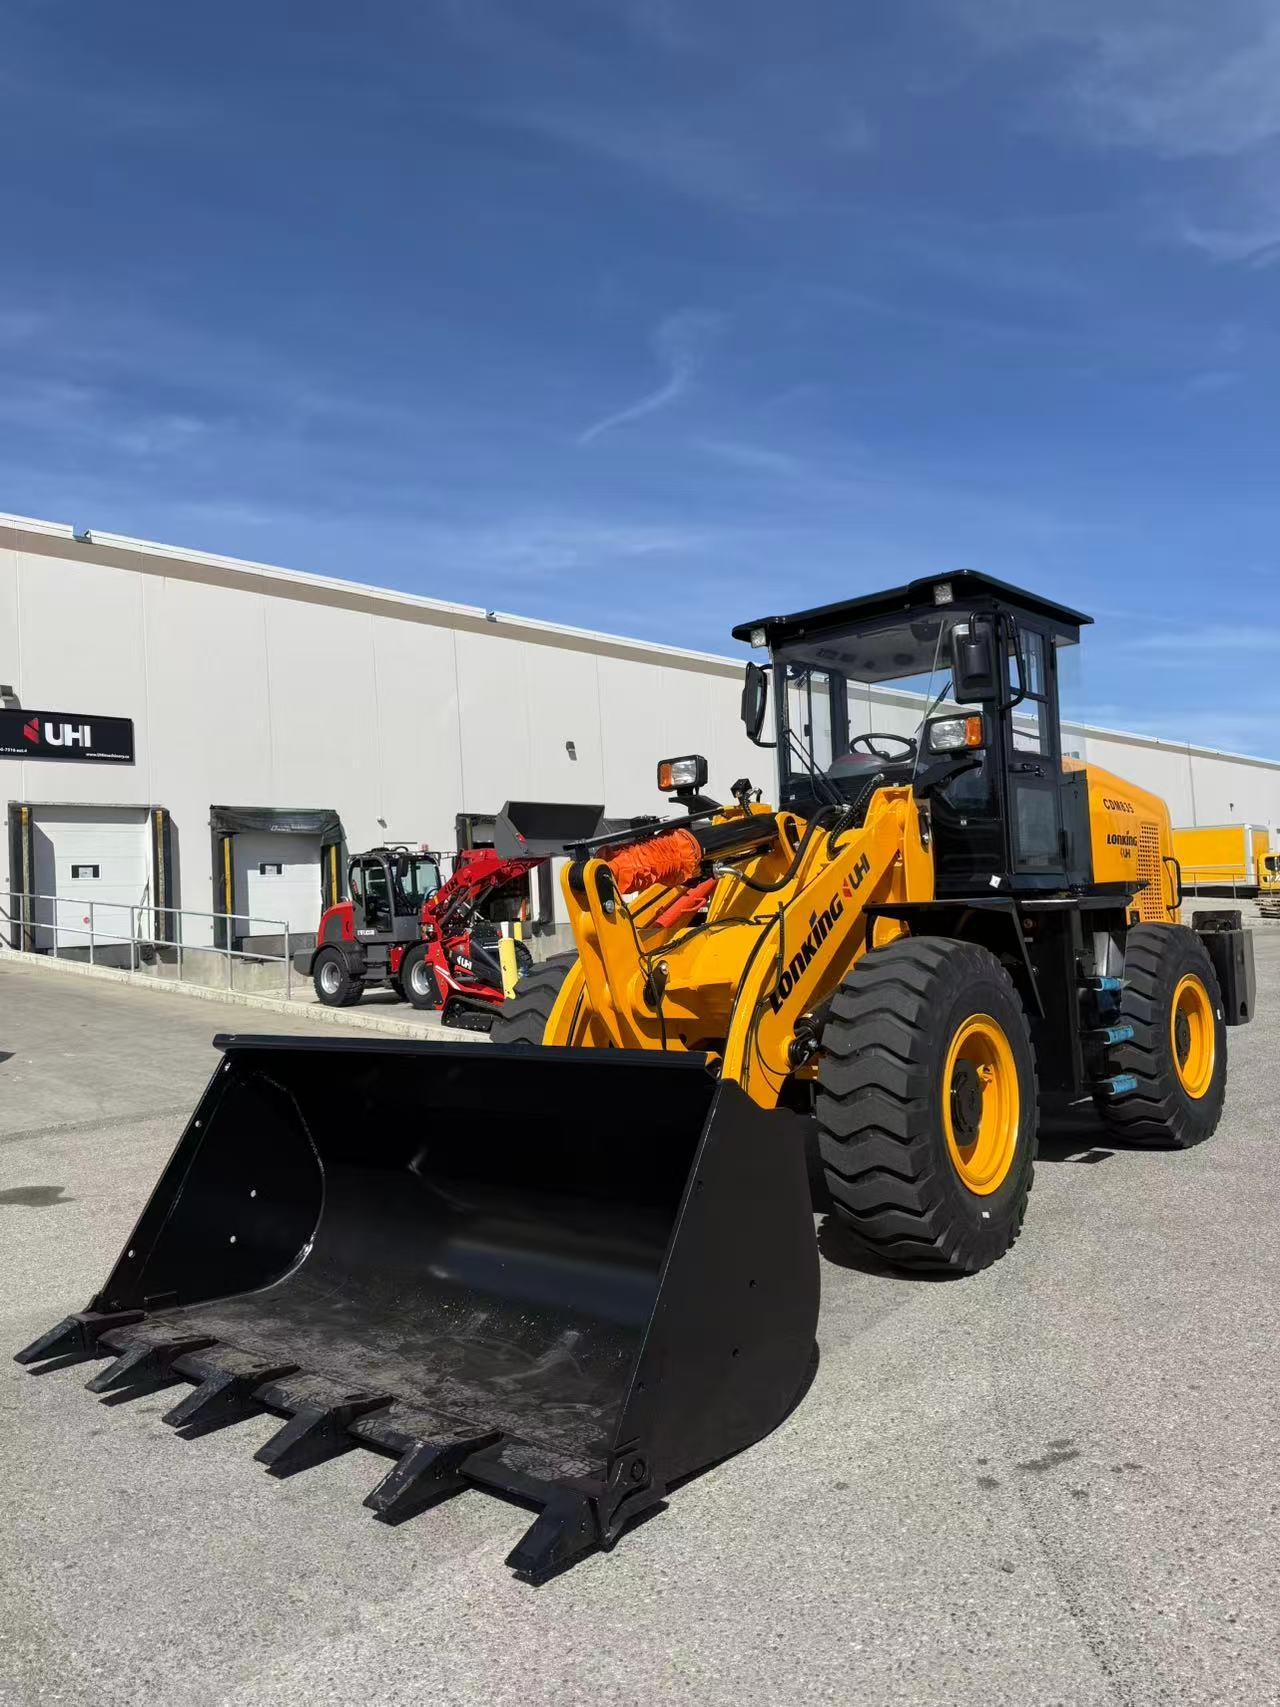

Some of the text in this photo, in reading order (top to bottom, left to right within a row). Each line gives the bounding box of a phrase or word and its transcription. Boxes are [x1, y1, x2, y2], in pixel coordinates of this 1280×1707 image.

[44, 722, 91, 747] UHI
[769, 852, 870, 1015] LONKING UHI
[461, 957, 473, 970] UHI
